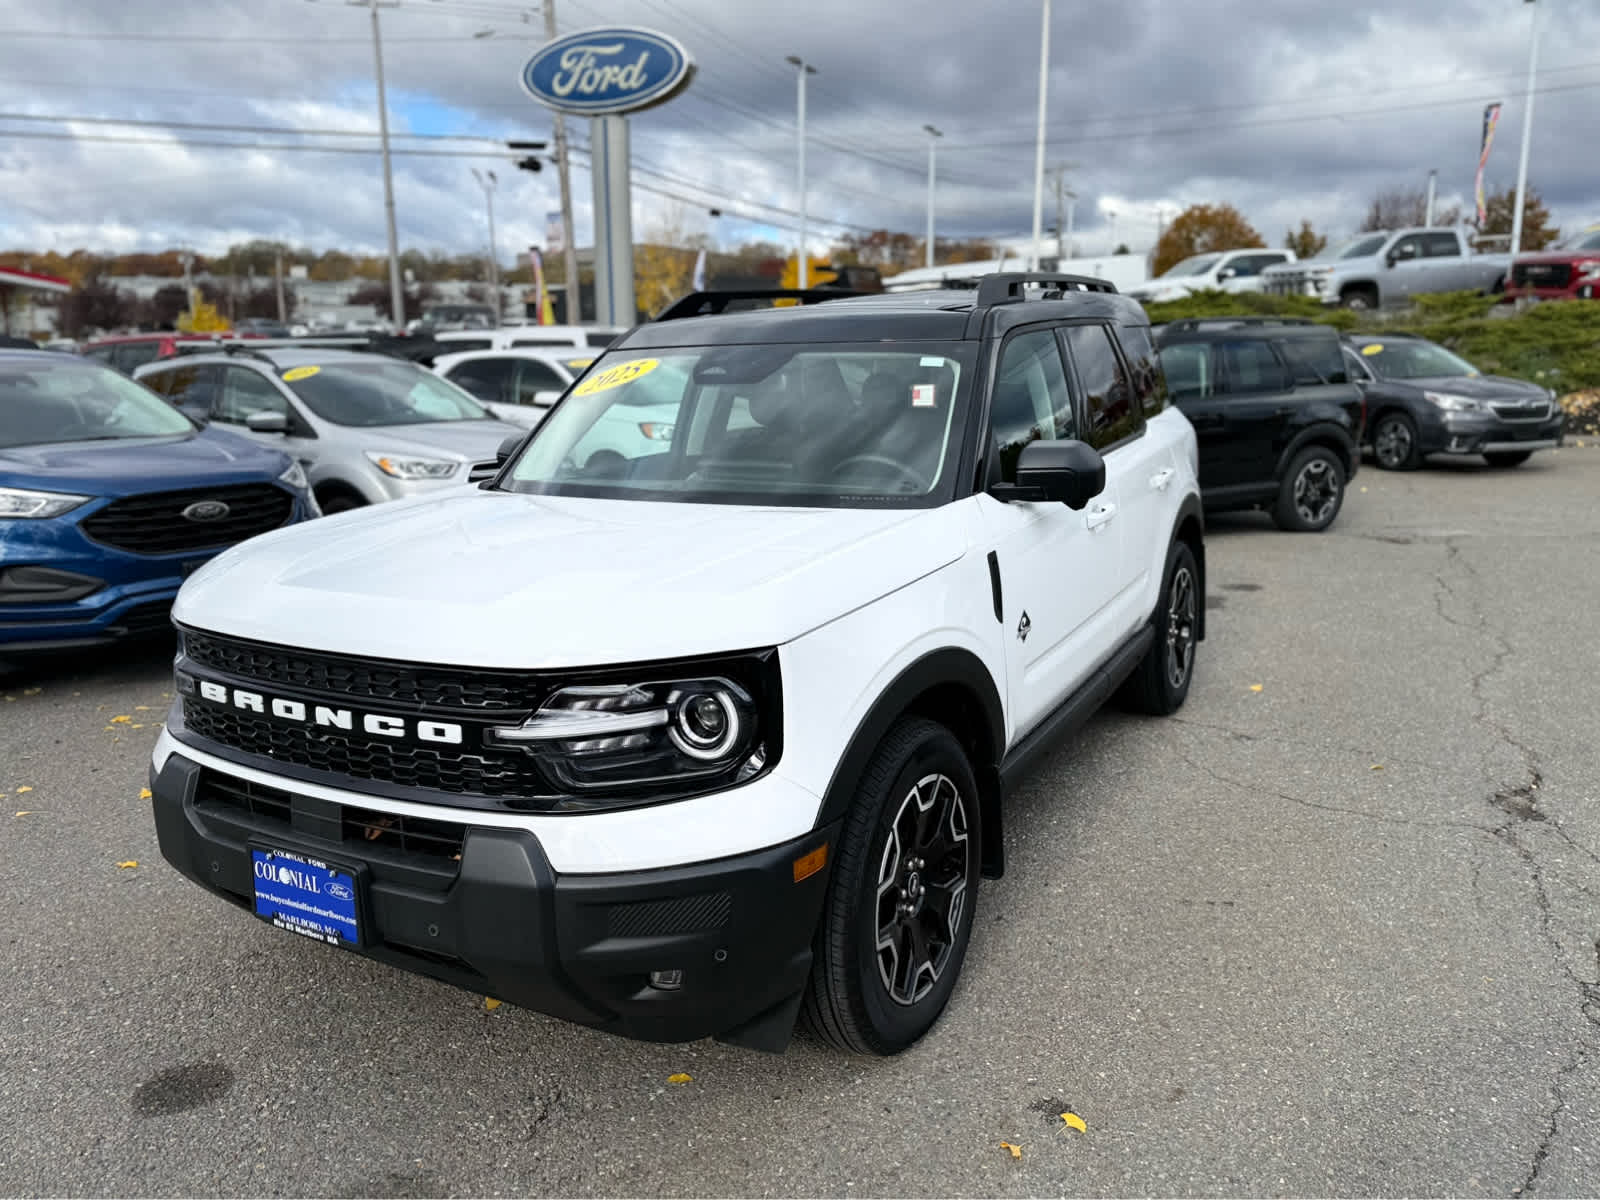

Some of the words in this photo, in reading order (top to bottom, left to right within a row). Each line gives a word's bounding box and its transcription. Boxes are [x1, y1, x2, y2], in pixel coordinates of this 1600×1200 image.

[552, 43, 649, 96] Ford
[582, 361, 648, 392] 2025
[200, 681, 462, 744] BRONCO
[254, 860, 321, 894] COLONIAL
[307, 859, 327, 869] FORD
[329, 884, 349, 899] Ford
[296, 925, 325, 941] Marlboro
[327, 935, 339, 945] MA
